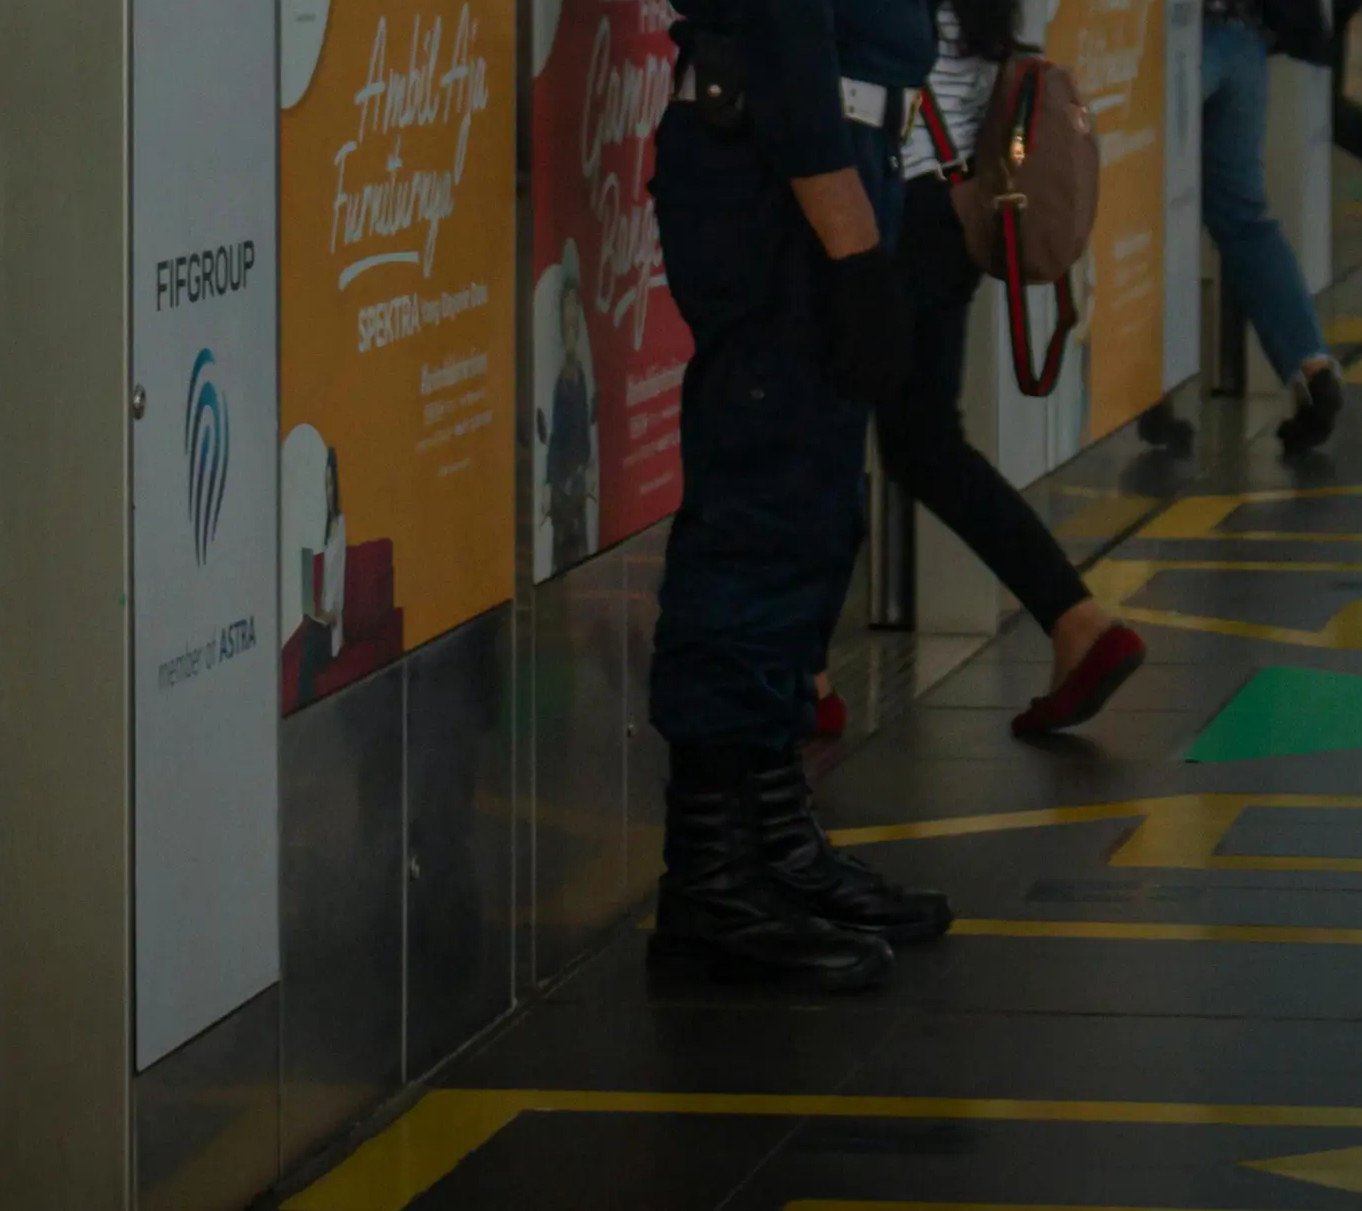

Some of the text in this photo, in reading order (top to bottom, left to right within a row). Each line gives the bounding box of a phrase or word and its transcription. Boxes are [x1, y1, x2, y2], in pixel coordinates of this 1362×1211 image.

[354, 2, 489, 185] Ambil Aja
[156, 240, 255, 312] FIFGROUP
[357, 292, 420, 353] SPEKTRA
[158, 615, 257, 693] member of ASTRA
